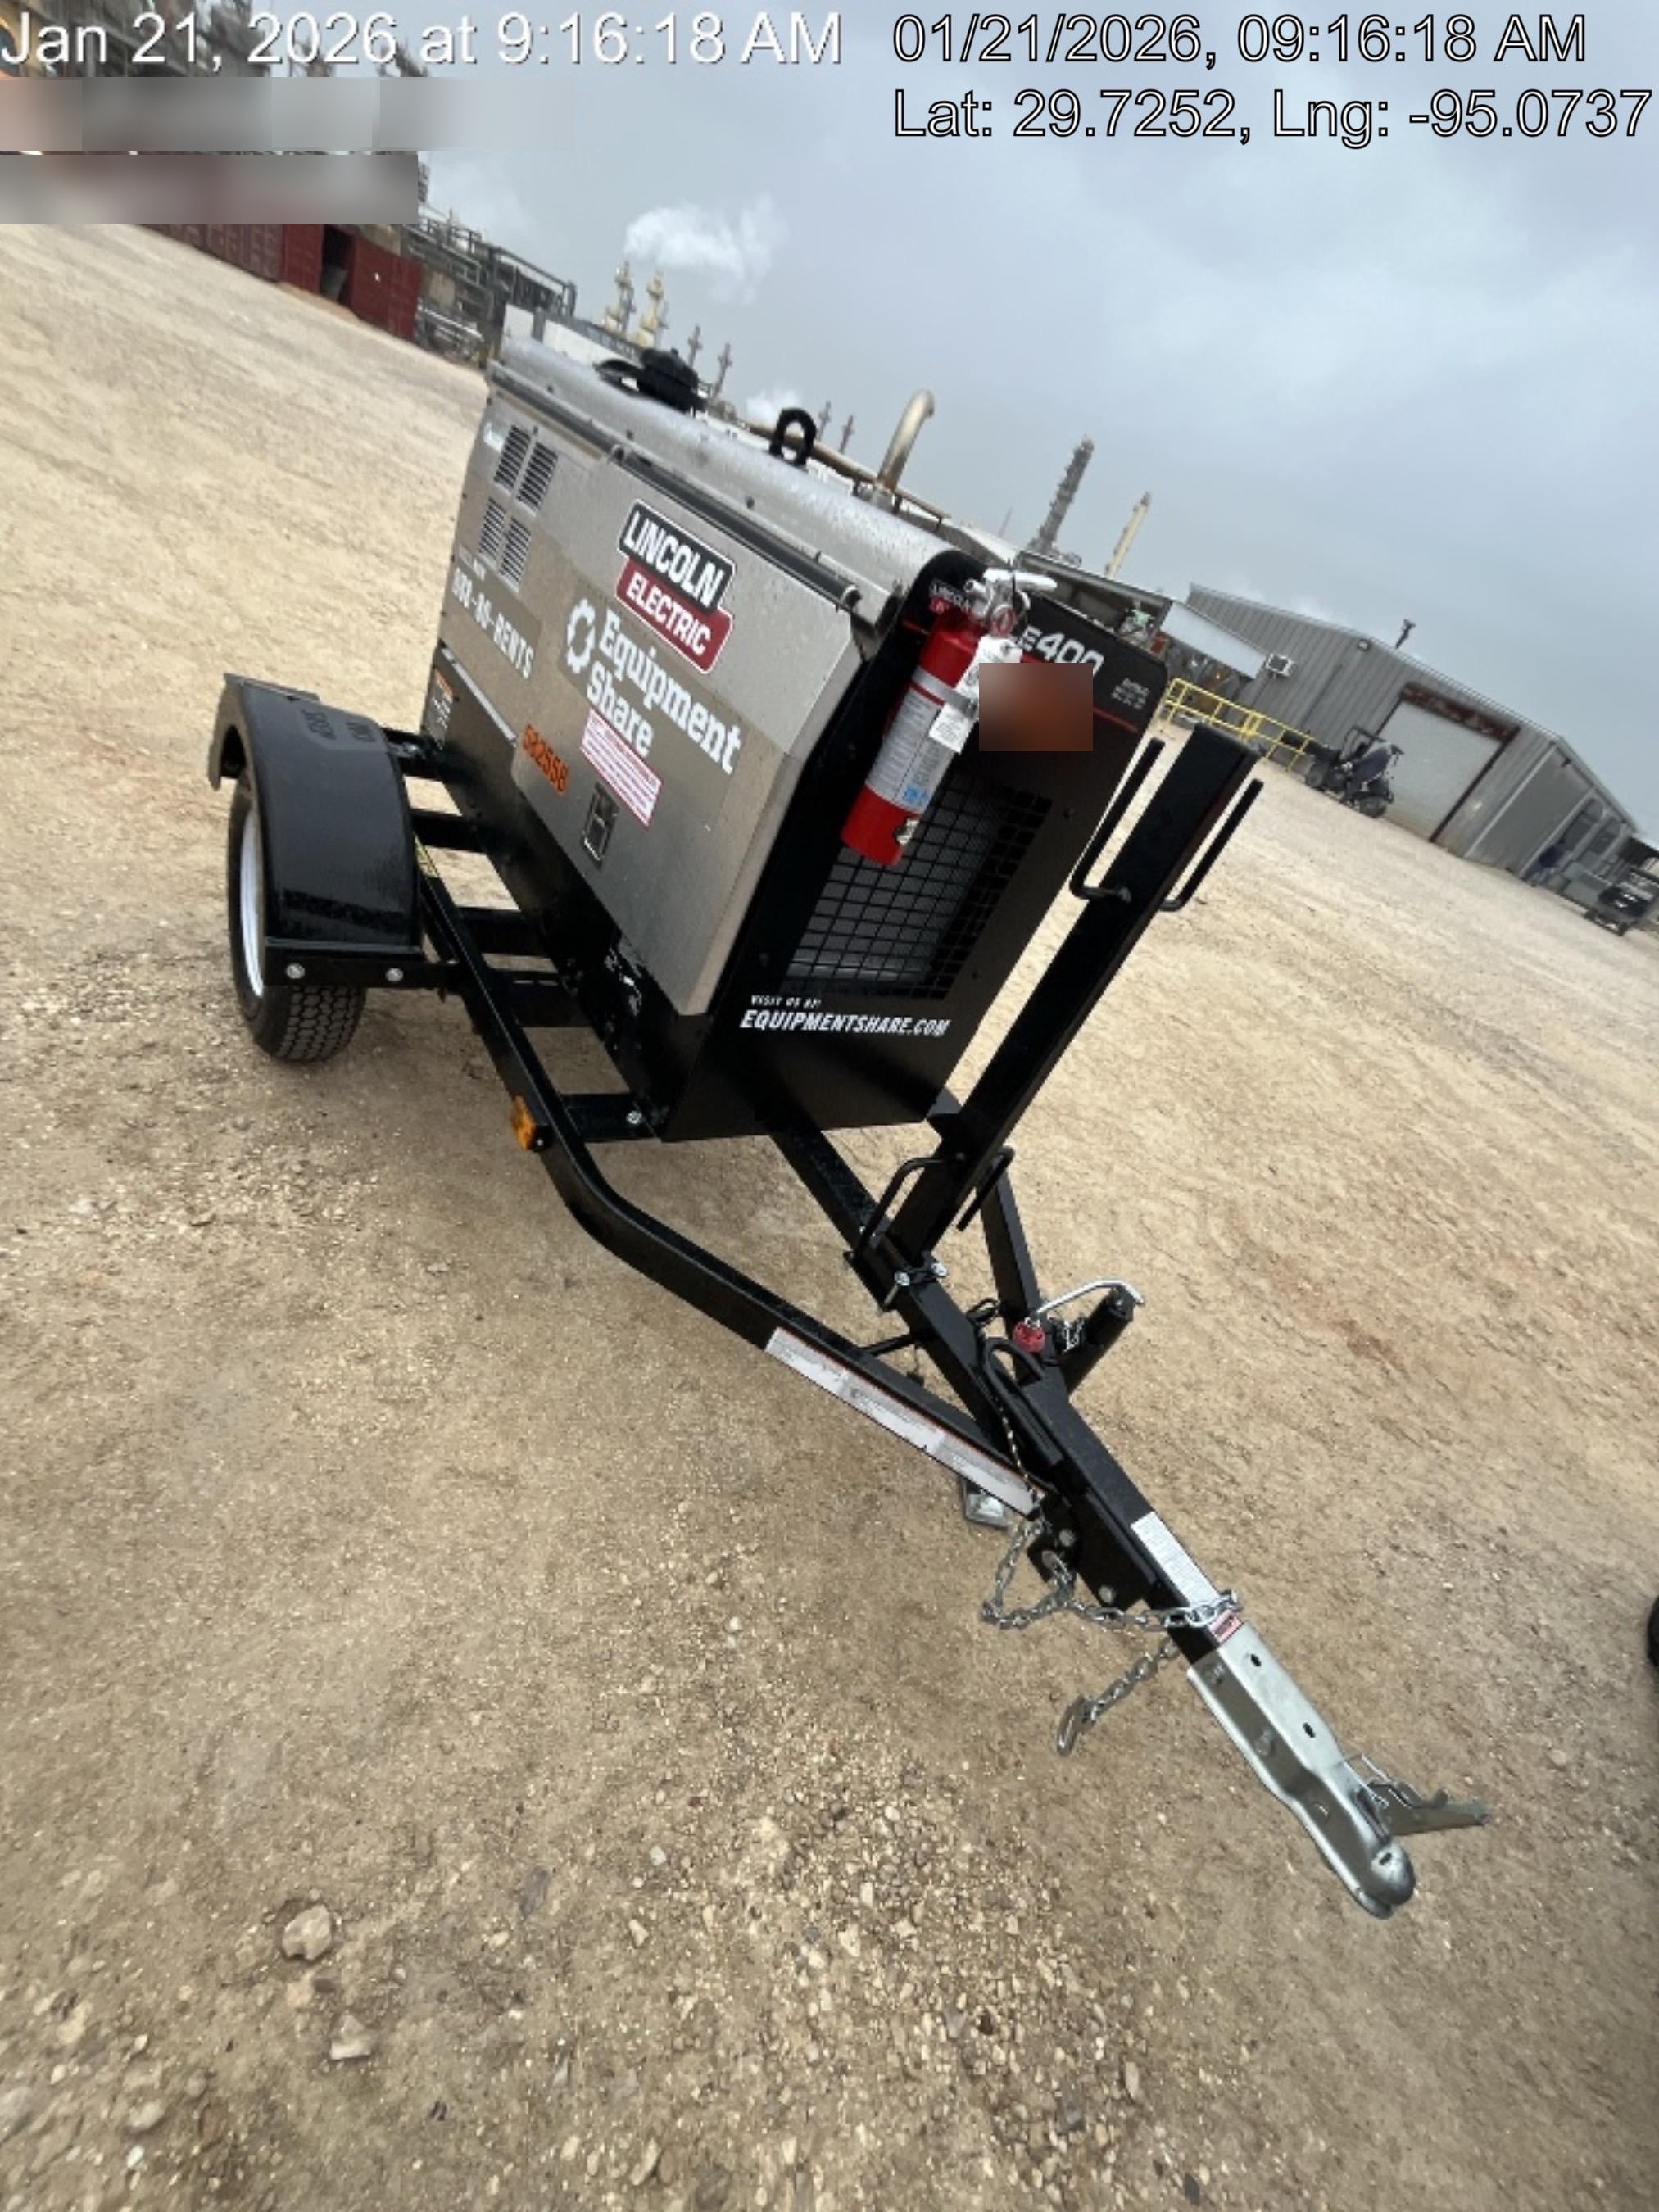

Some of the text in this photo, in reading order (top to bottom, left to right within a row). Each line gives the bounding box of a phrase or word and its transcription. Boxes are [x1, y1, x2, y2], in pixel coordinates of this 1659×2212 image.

[623, 510, 724, 608] LINCOLN
[626, 572, 712, 655] ELECTRIC
[587, 660, 653, 757] Share
[599, 608, 741, 774] Equipment
[740, 1009, 950, 1037] EQUIPMENTSHARE.COM
